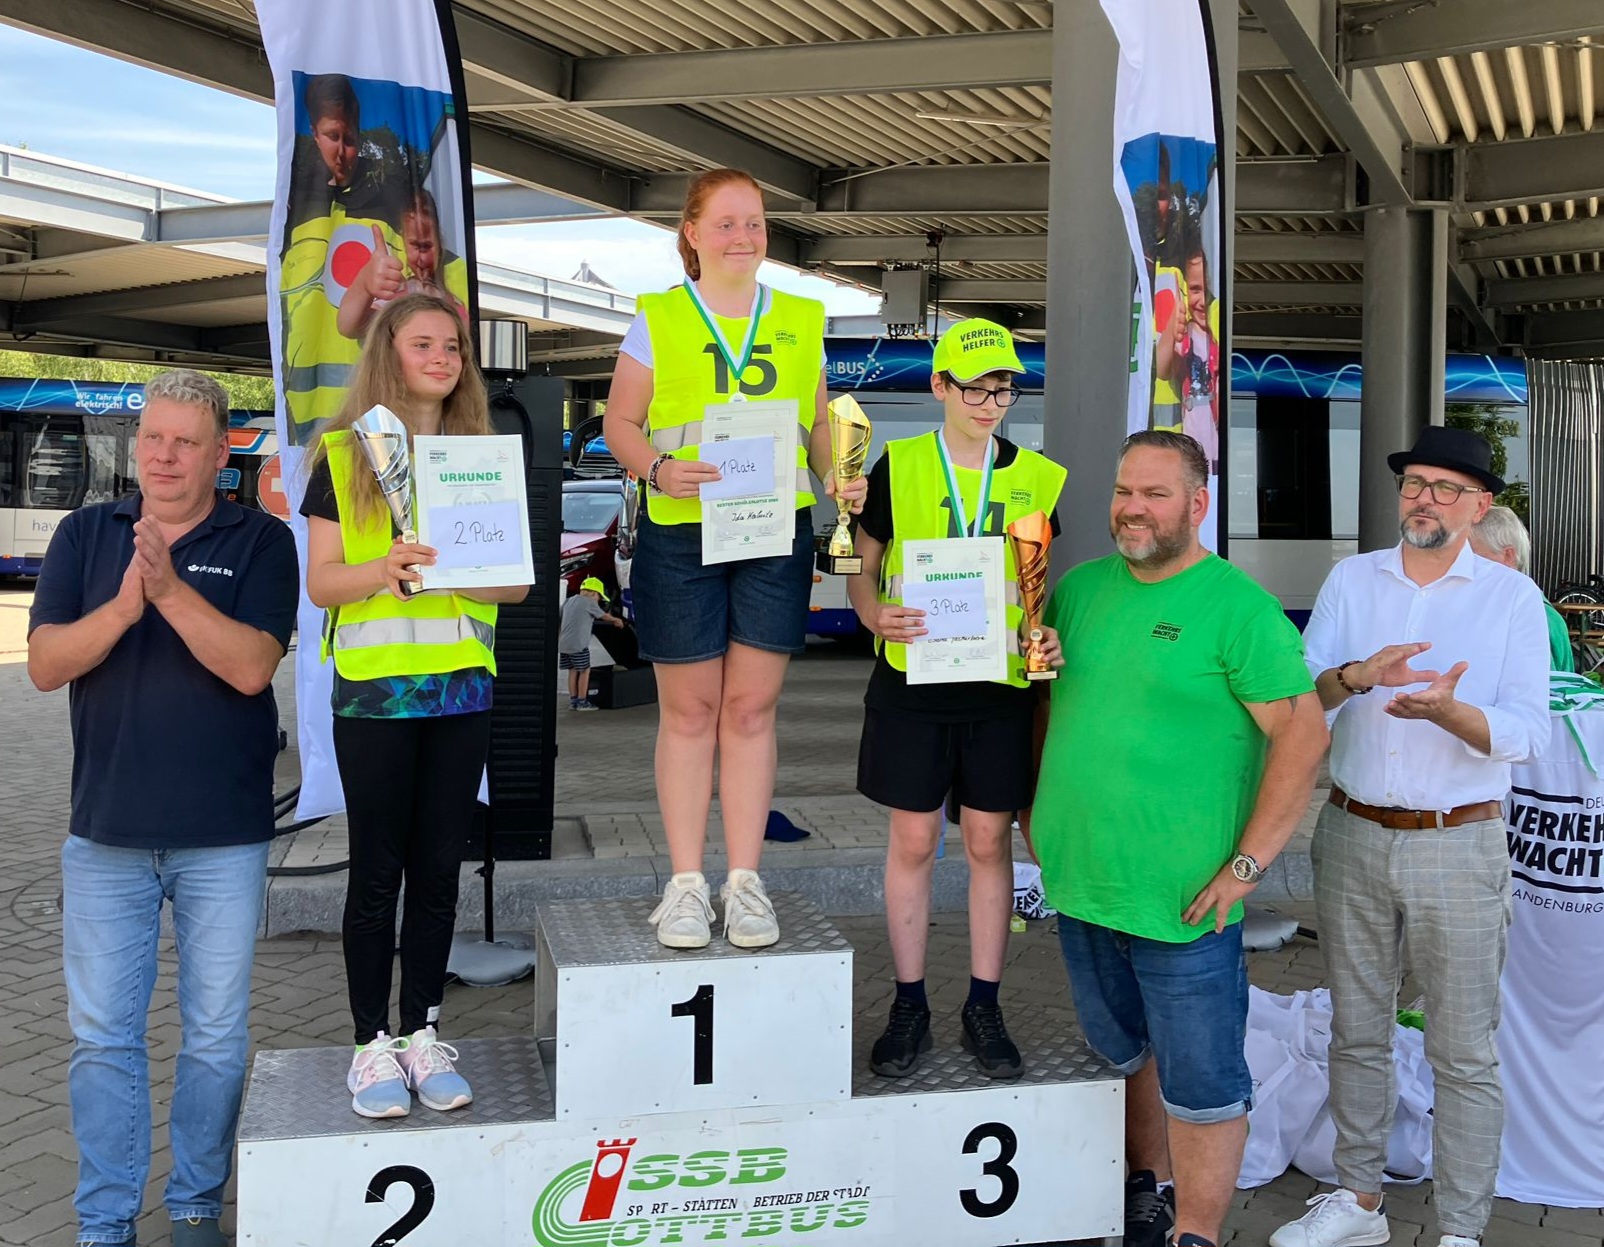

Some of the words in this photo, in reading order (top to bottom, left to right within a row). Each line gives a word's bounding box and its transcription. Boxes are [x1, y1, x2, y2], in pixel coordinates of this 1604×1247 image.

[960, 328, 1004, 343] VERKEHRS
[963, 338, 996, 353] HELFER
[702, 342, 778, 396] 15
[439, 472, 502, 482] URKUNDE
[728, 458, 757, 474] Platz
[469, 521, 506, 543] Platz
[940, 598, 970, 615] Platz
[1506, 831, 1603, 878] WACHT
[671, 984, 714, 1086] 1
[627, 1147, 788, 1191] SSB
[959, 1121, 1019, 1218] 3
[364, 1164, 435, 1247] 2
[753, 1193, 803, 1207] BETRIEB
[805, 1190, 830, 1203] DER
